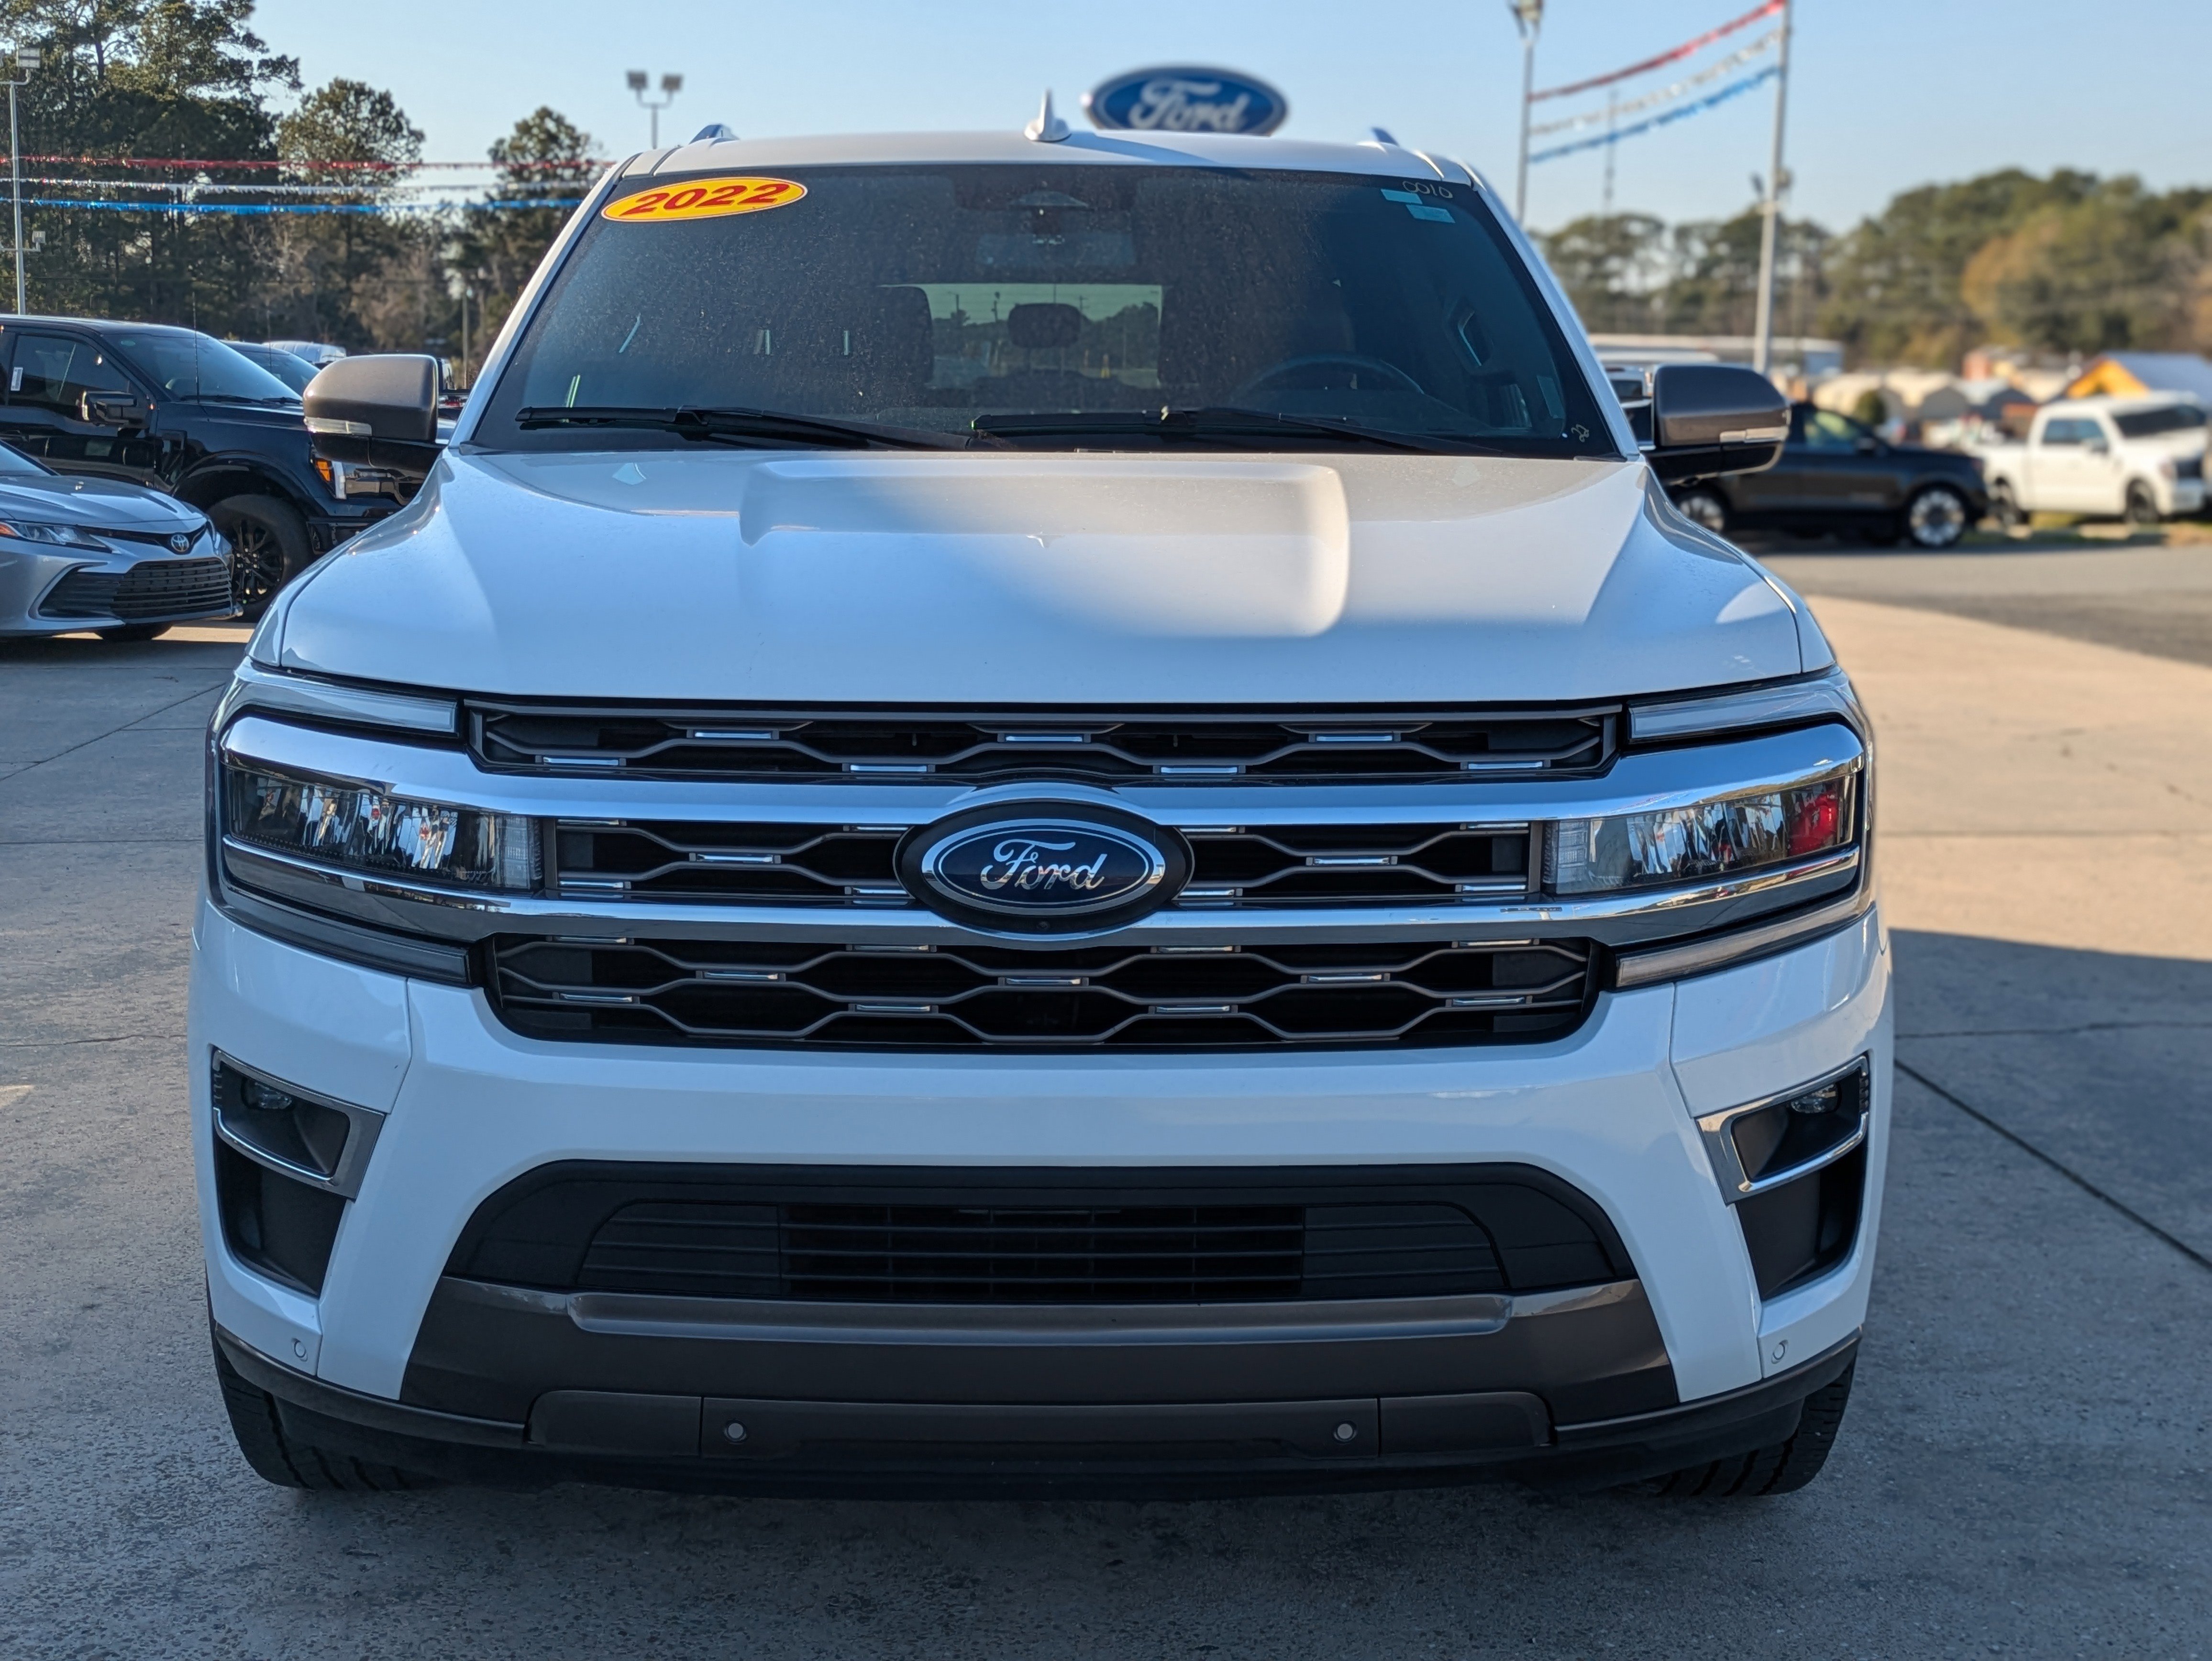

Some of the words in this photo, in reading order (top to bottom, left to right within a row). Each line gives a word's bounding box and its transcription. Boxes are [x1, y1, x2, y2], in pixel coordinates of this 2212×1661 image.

[1128, 78, 1250, 132] Ford
[619, 184, 792, 217] 2022
[980, 838, 1108, 890] Ford
